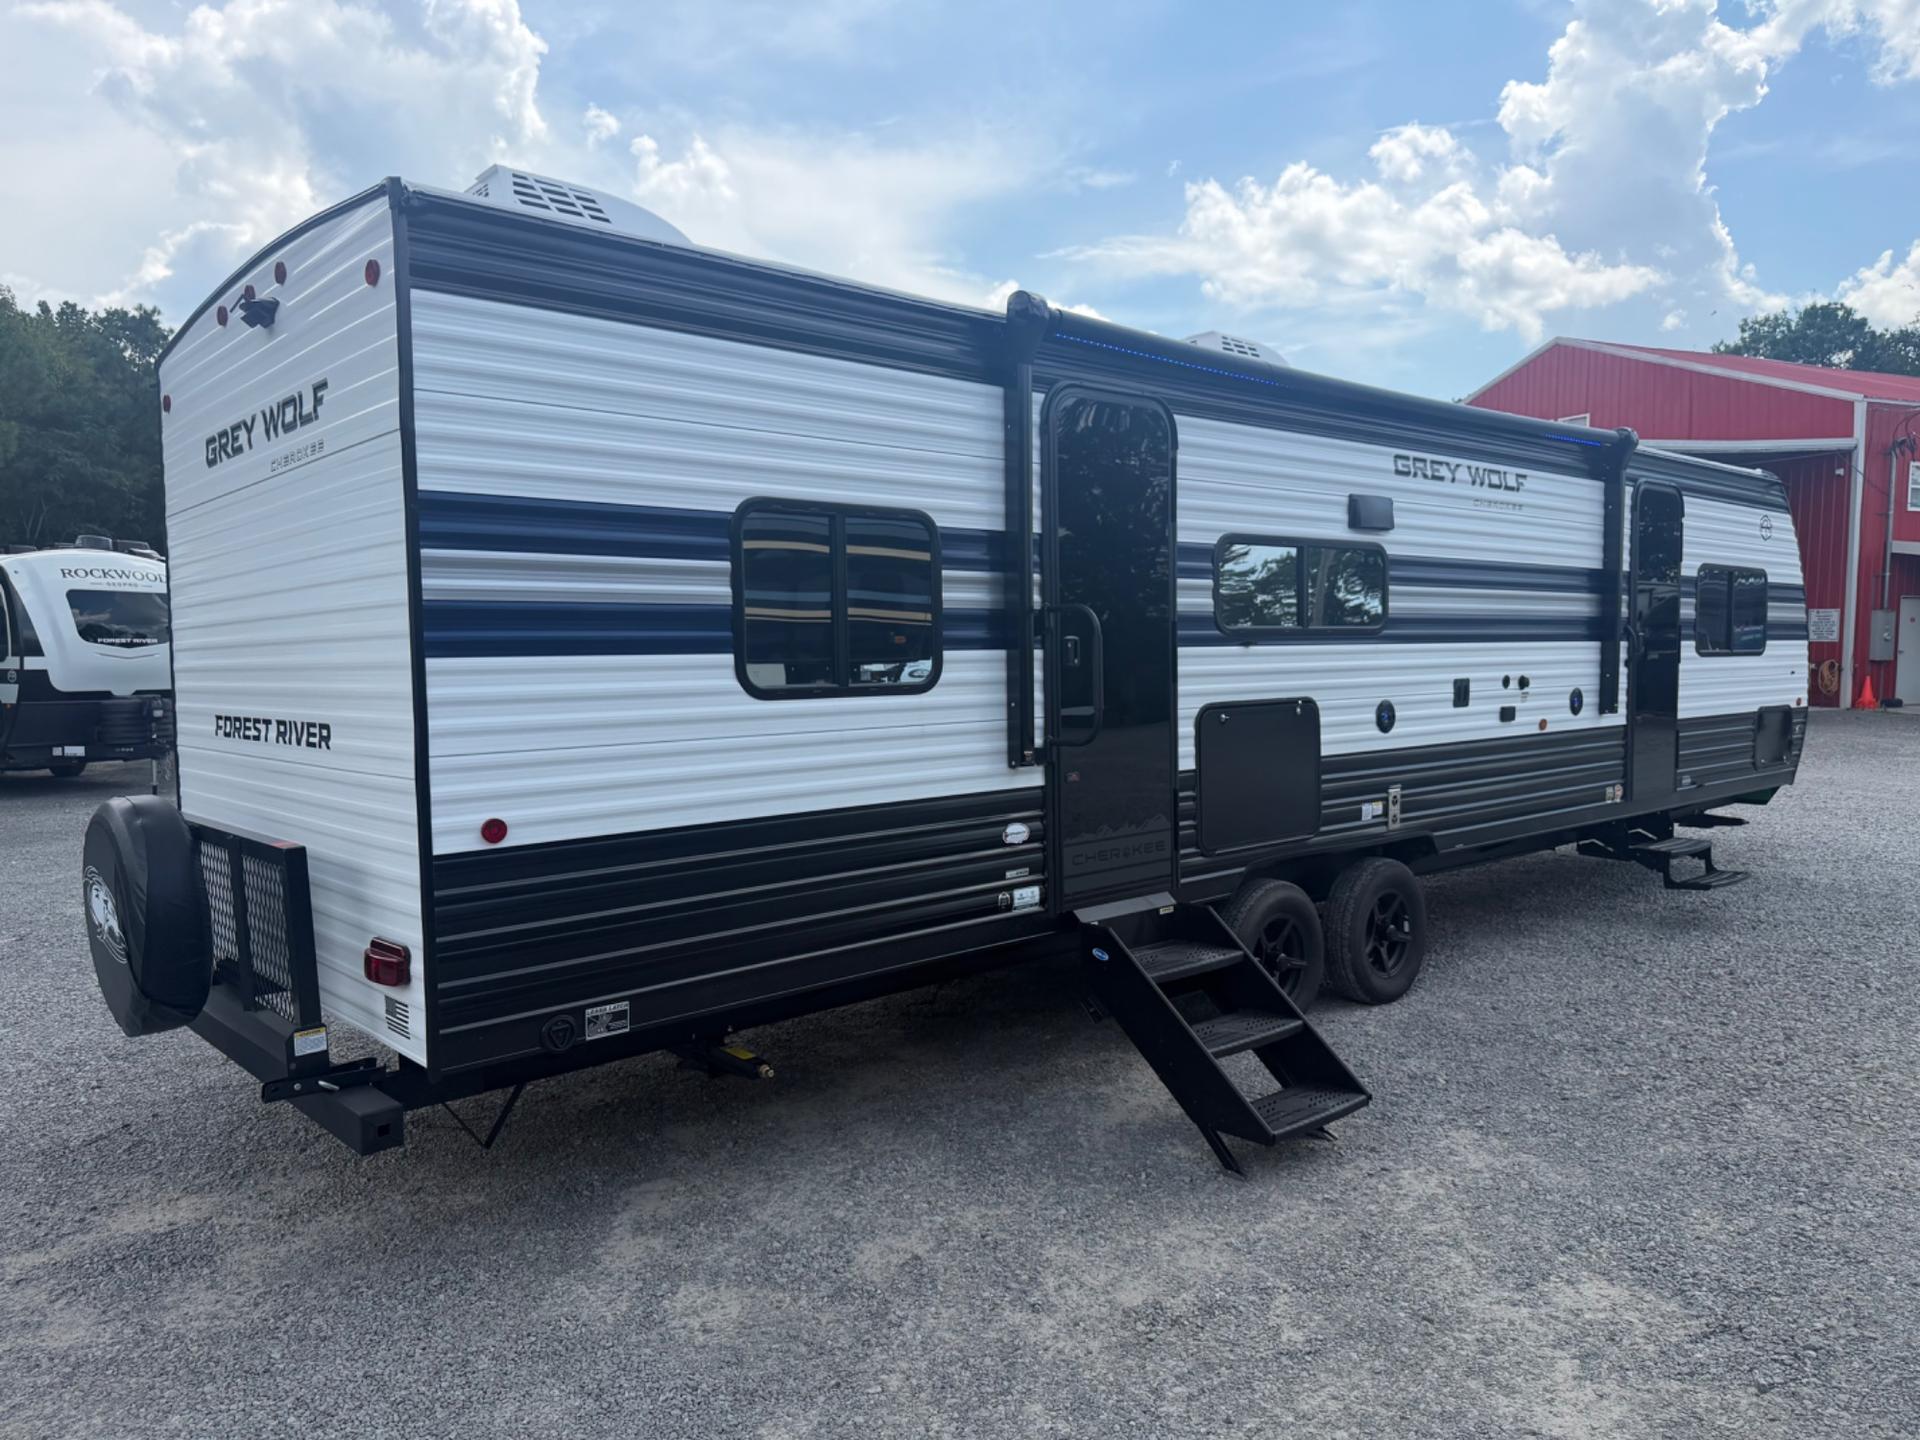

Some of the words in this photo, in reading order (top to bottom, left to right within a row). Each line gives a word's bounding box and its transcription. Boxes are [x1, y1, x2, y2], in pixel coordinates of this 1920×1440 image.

[206, 413, 256, 467] GREY
[260, 377, 329, 440] WOLF
[271, 438, 325, 472] CHEROKEE
[1394, 454, 1462, 483] GREY
[1467, 465, 1527, 492] WOLF
[215, 714, 273, 742] FOREST
[274, 718, 331, 751] RIVER
